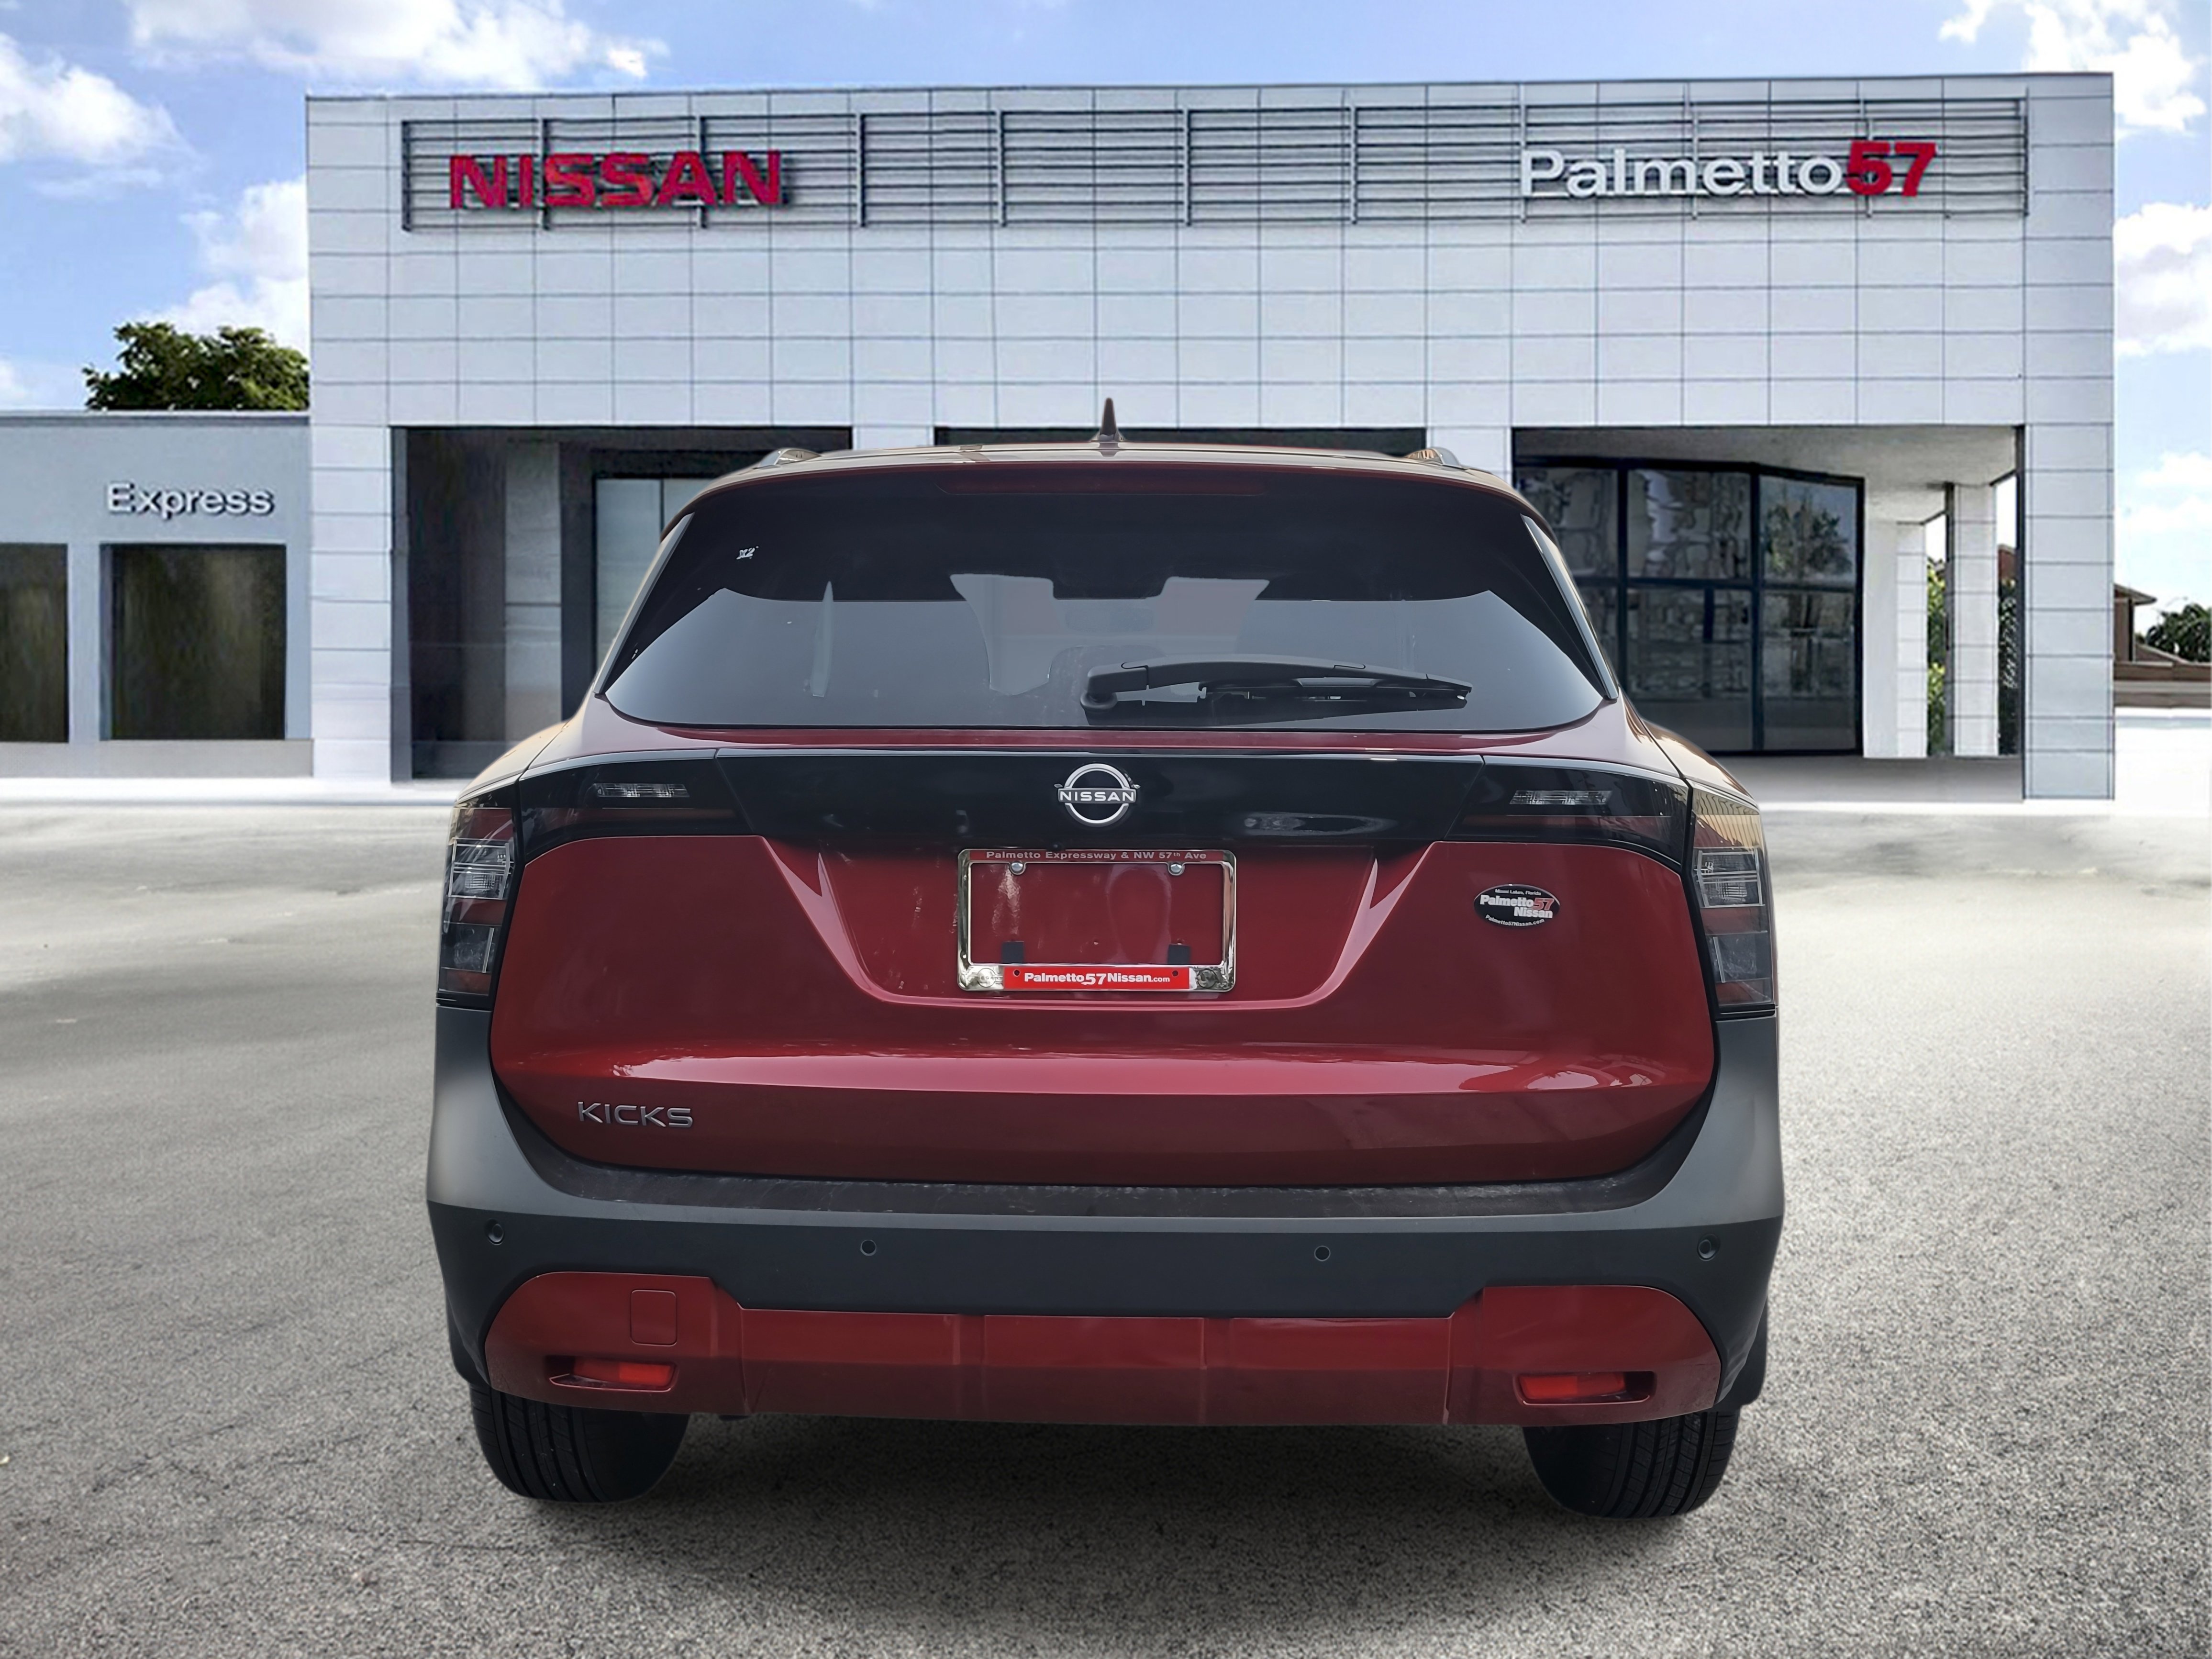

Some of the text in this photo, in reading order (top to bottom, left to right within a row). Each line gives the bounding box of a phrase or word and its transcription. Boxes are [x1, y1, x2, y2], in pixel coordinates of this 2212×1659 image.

[450, 150, 782, 208] NISSAN
[107, 482, 274, 520] Express
[1059, 791, 1134, 802] NISSAN
[1045, 851, 1116, 859] Expressway
[1513, 906, 1553, 919] Nissan
[1485, 914, 1545, 926] Palmetto57Nissan.com
[1024, 972, 1170, 985] Palmetto57Nissan.com
[578, 1102, 693, 1128] KICKS
